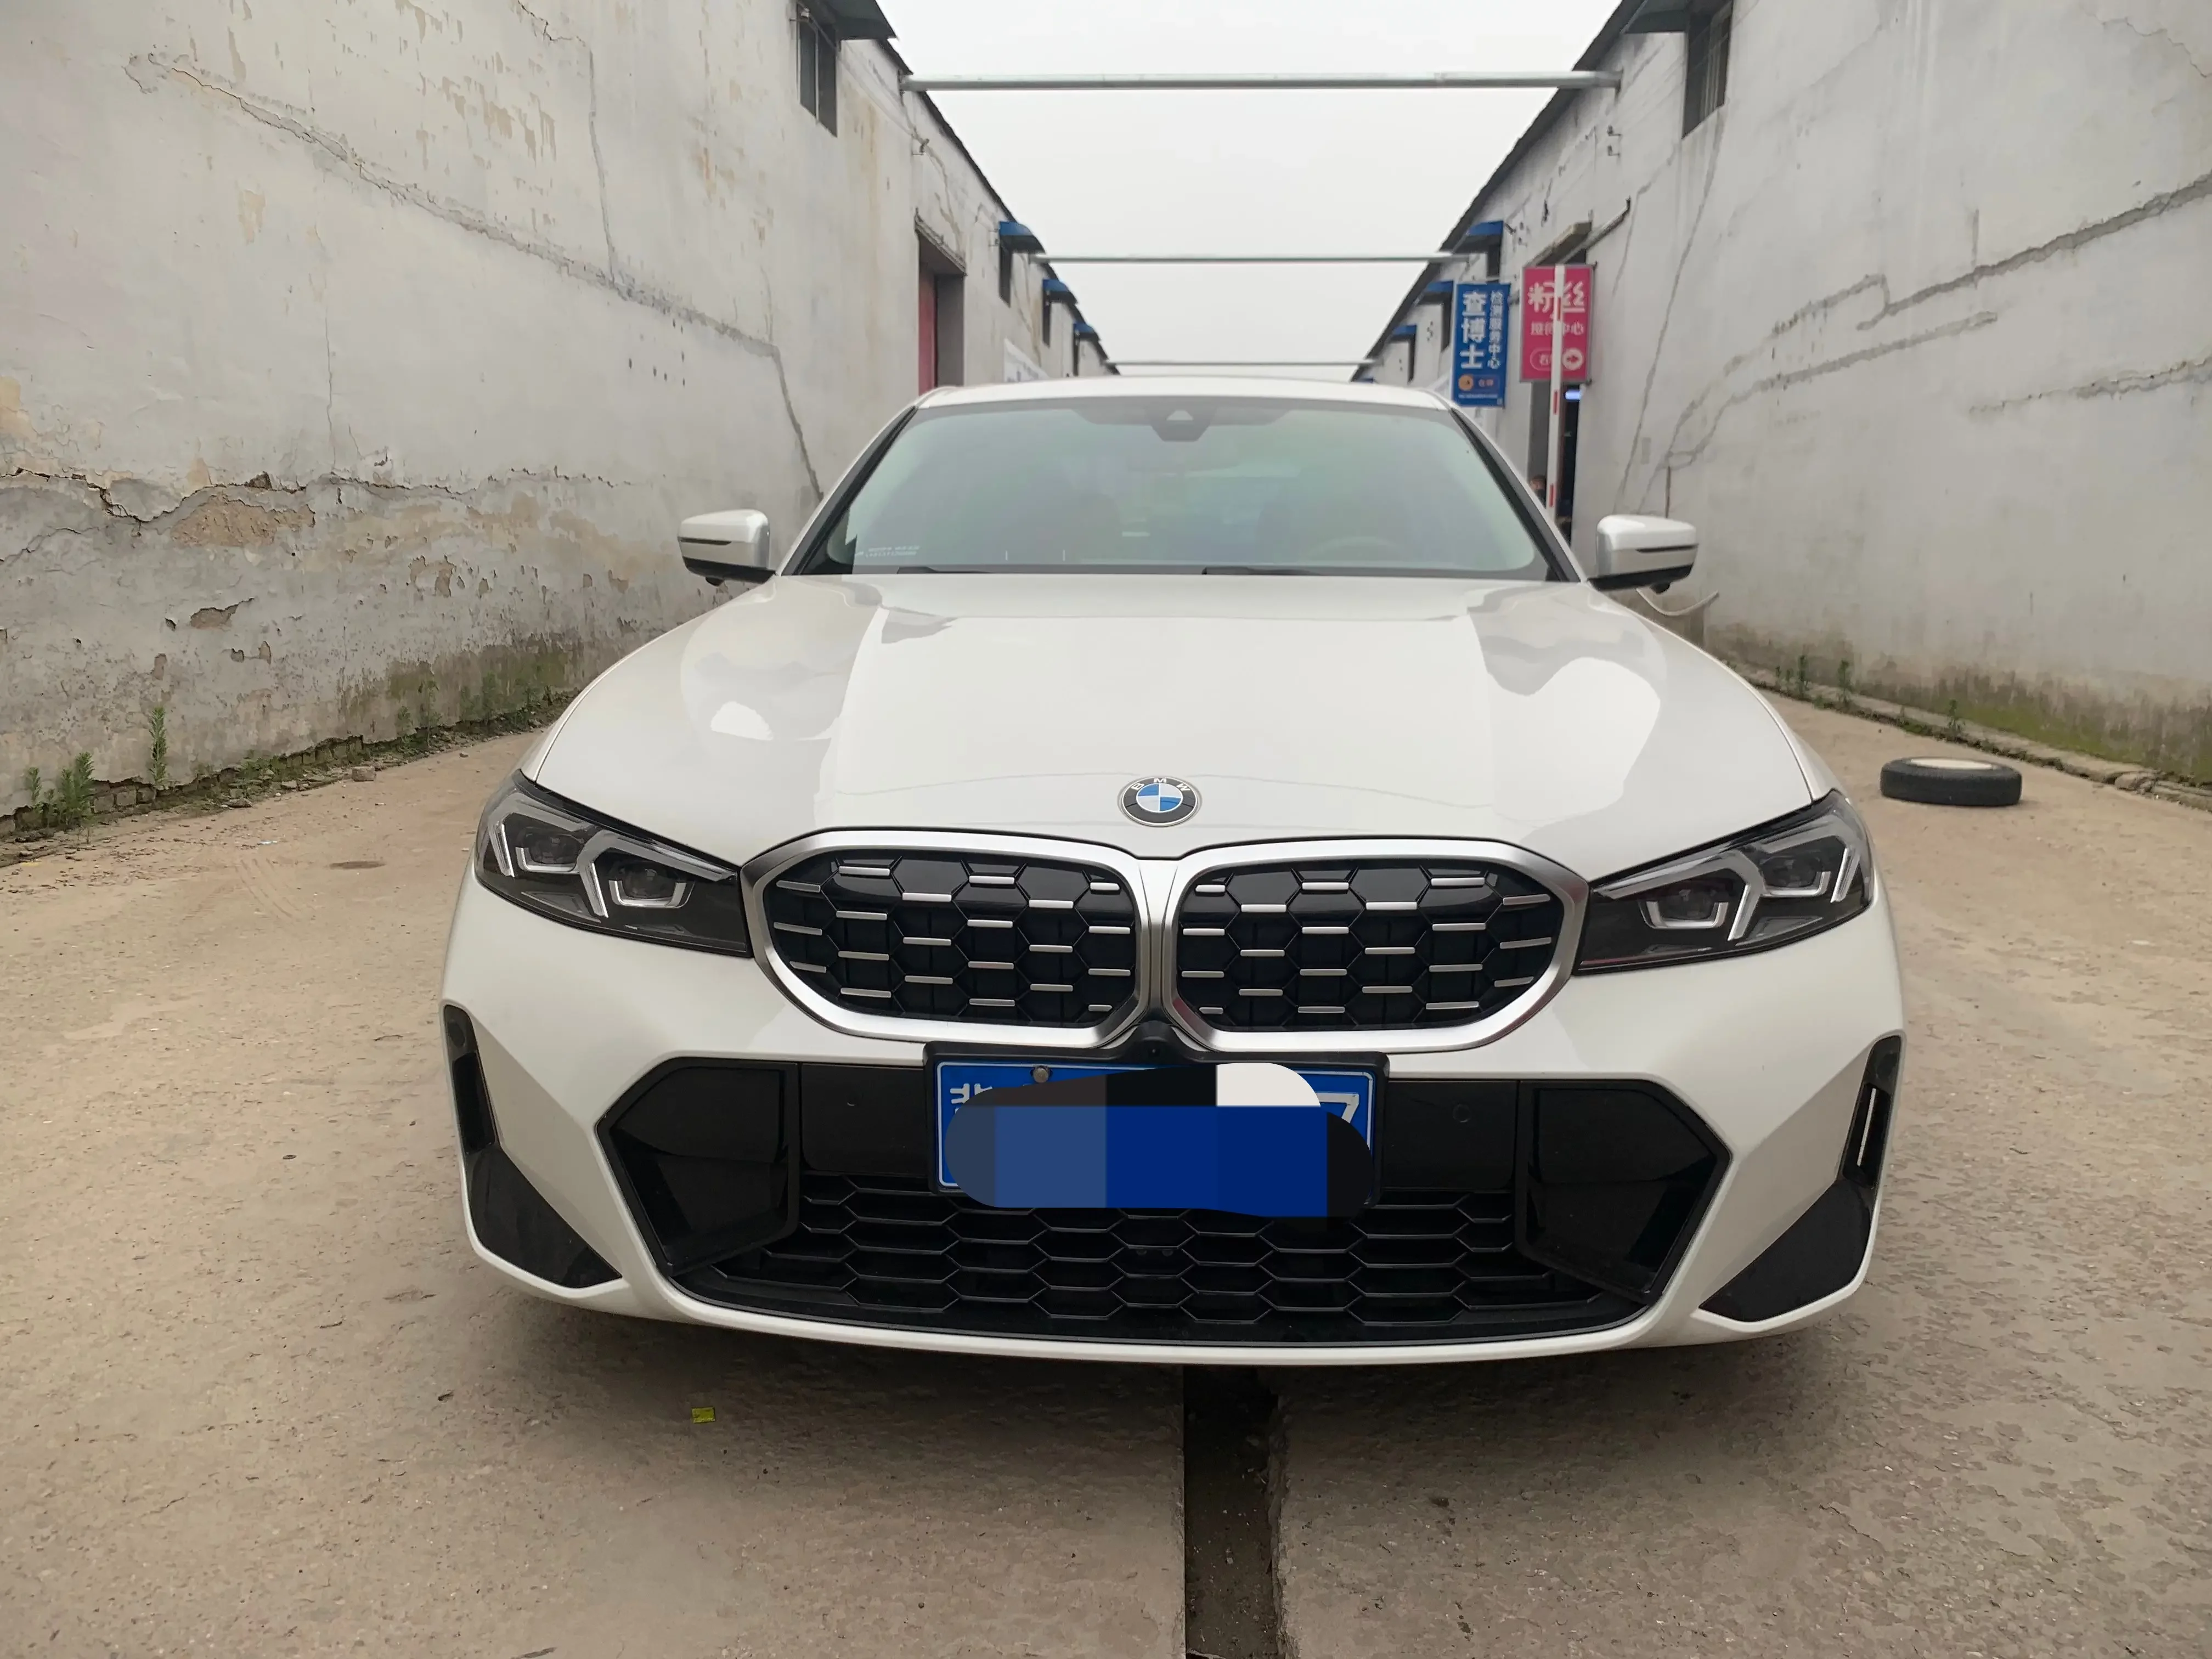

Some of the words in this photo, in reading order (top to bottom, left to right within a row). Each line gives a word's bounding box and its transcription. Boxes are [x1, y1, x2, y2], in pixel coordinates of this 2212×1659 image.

[1459, 290, 1487, 369] 查博士
[1131, 777, 1190, 791] BMW
